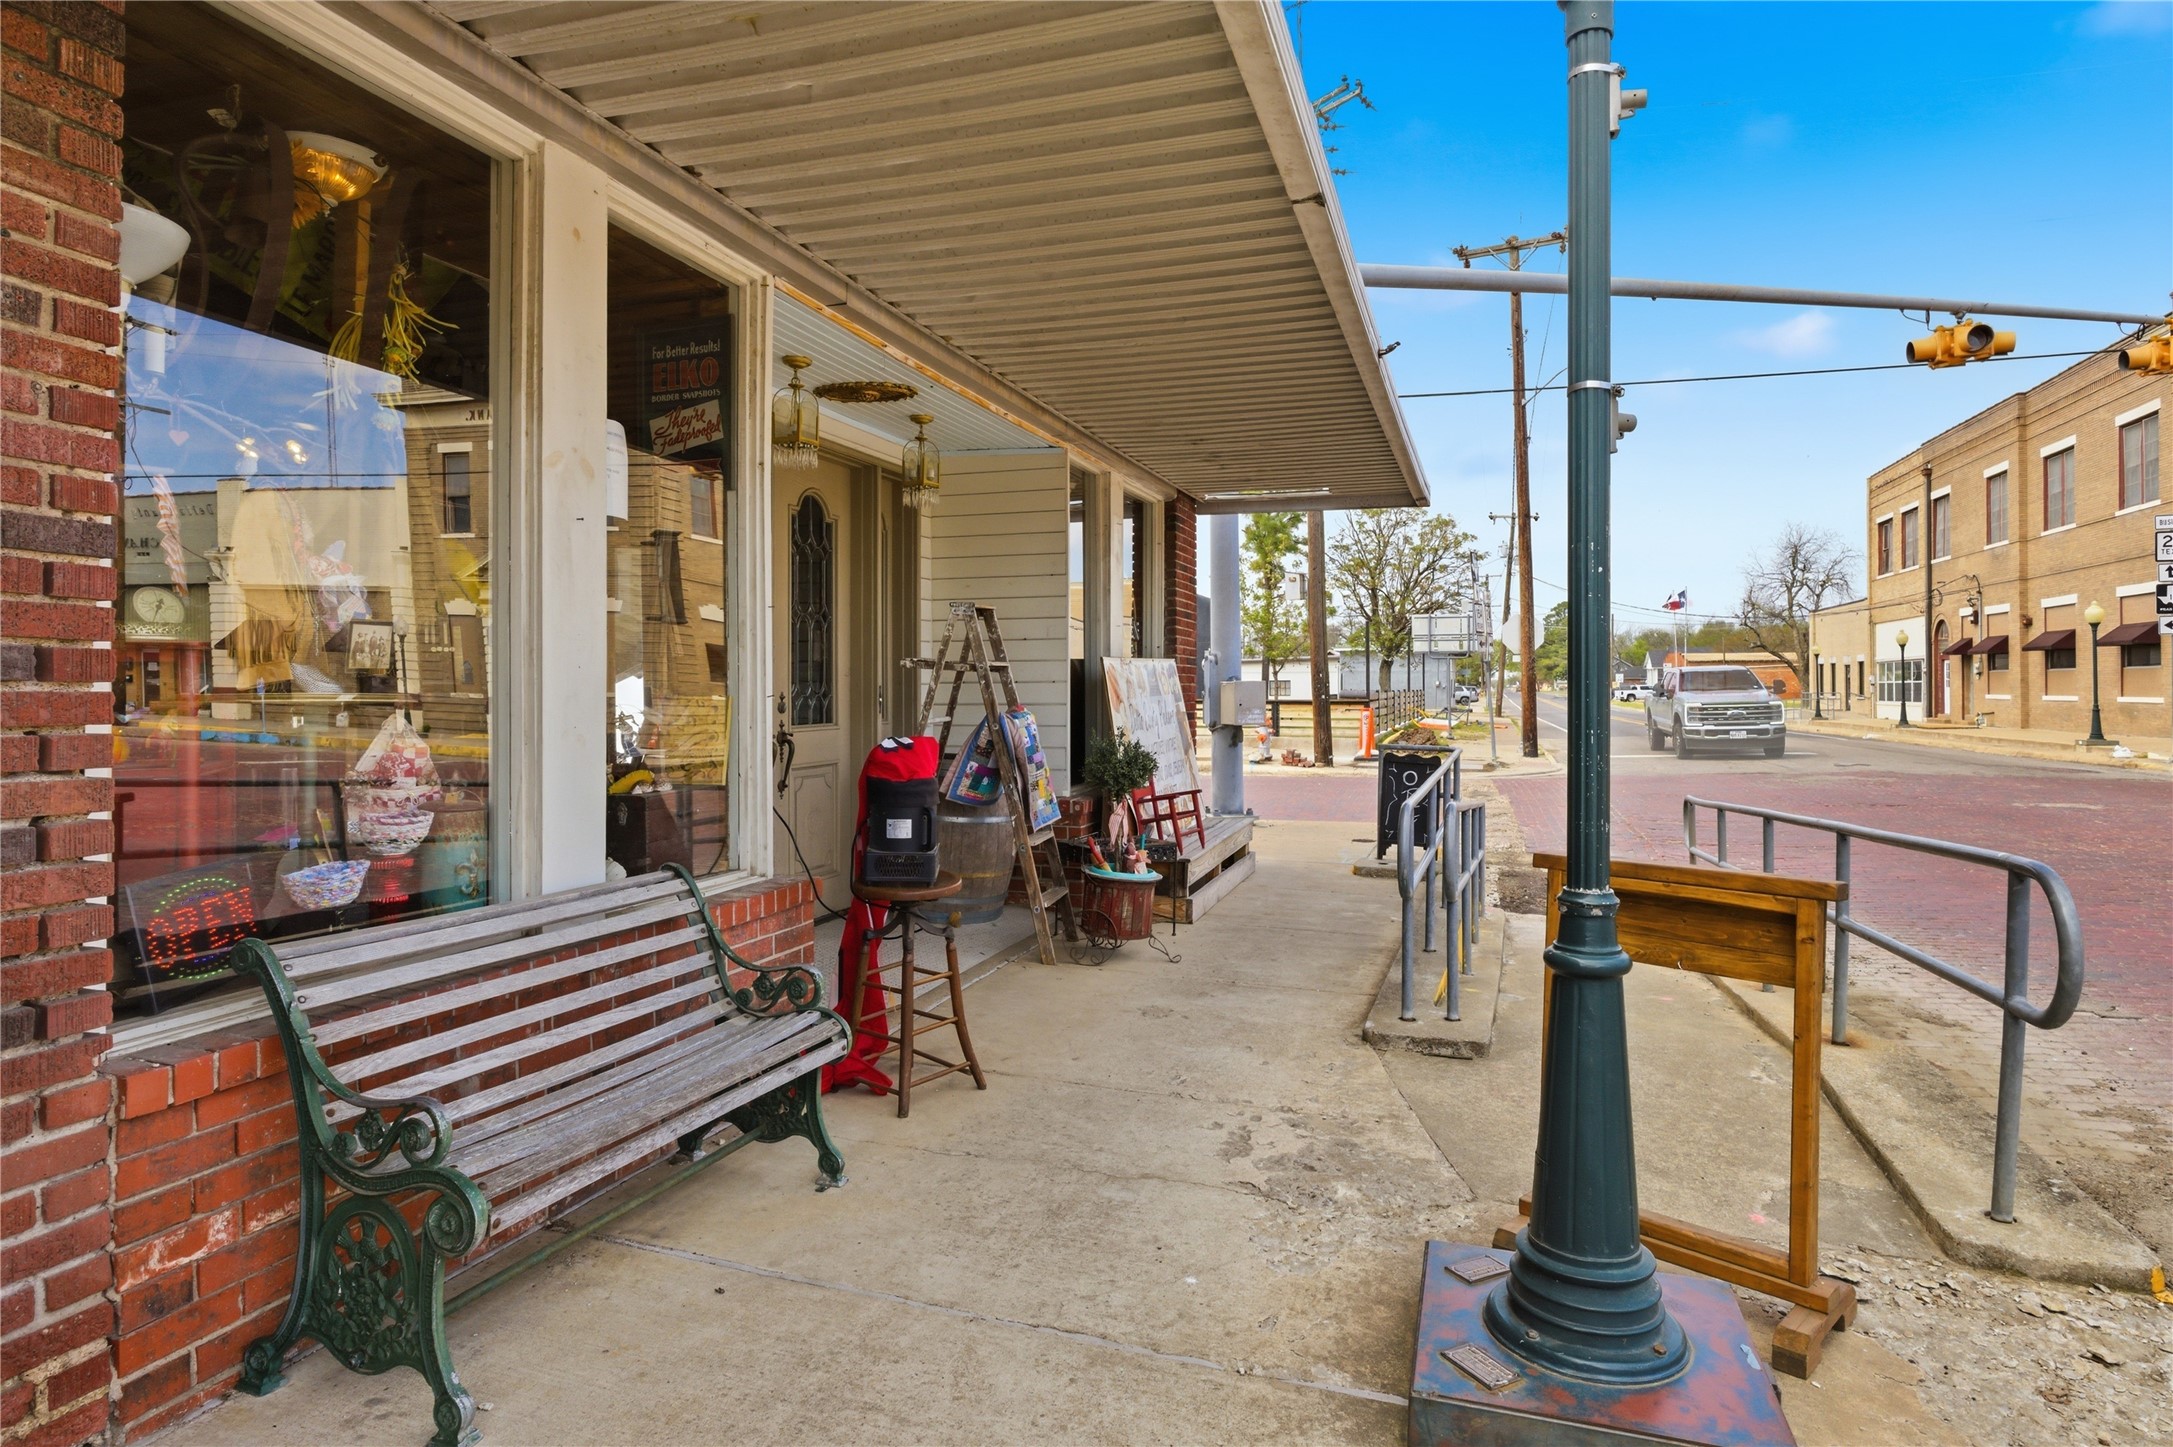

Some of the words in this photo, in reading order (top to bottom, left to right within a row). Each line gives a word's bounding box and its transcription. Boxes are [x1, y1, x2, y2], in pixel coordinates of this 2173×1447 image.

[652, 346, 665, 360] For
[665, 345, 689, 358] Better
[690, 338, 721, 355] Results!
[652, 356, 720, 393] ELKO
[654, 405, 706, 436] They're
[146, 886, 258, 970] OPEN
